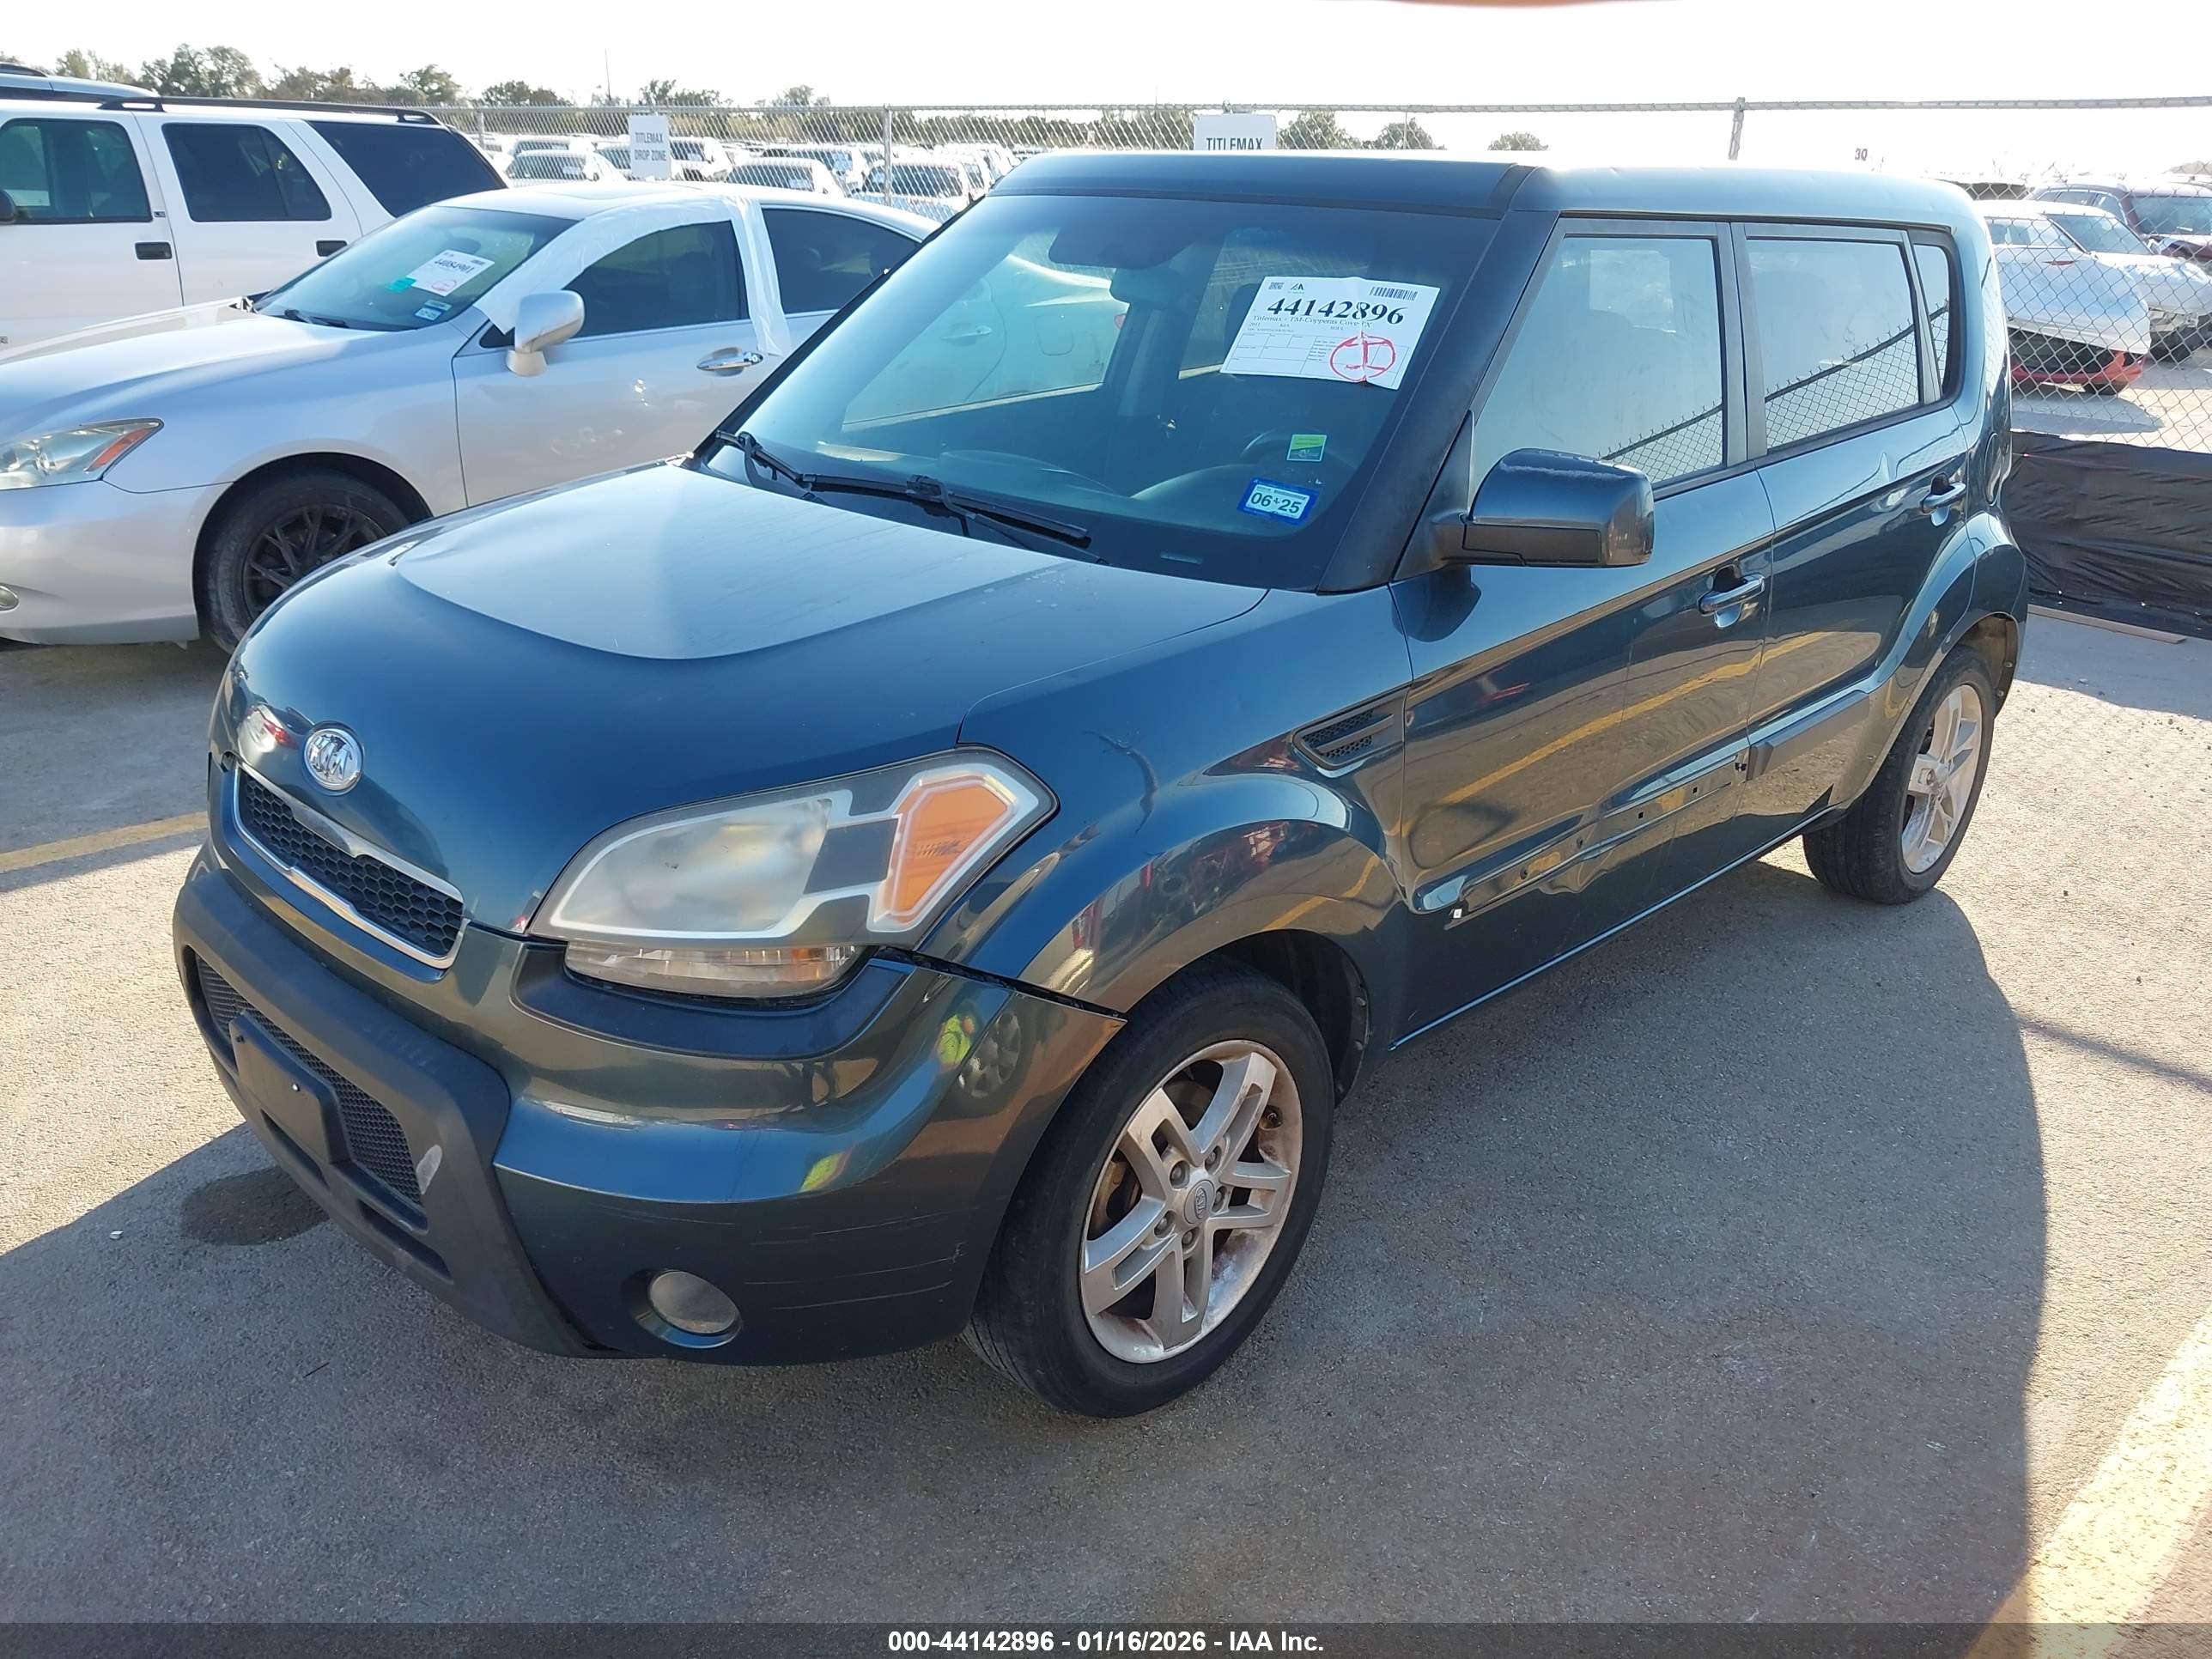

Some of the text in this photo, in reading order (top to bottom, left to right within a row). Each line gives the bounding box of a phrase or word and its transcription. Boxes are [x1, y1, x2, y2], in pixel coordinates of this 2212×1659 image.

[1267, 297, 1409, 325] 44142896
[1250, 492, 1273, 507] 06
[1278, 498, 1302, 514] 25
